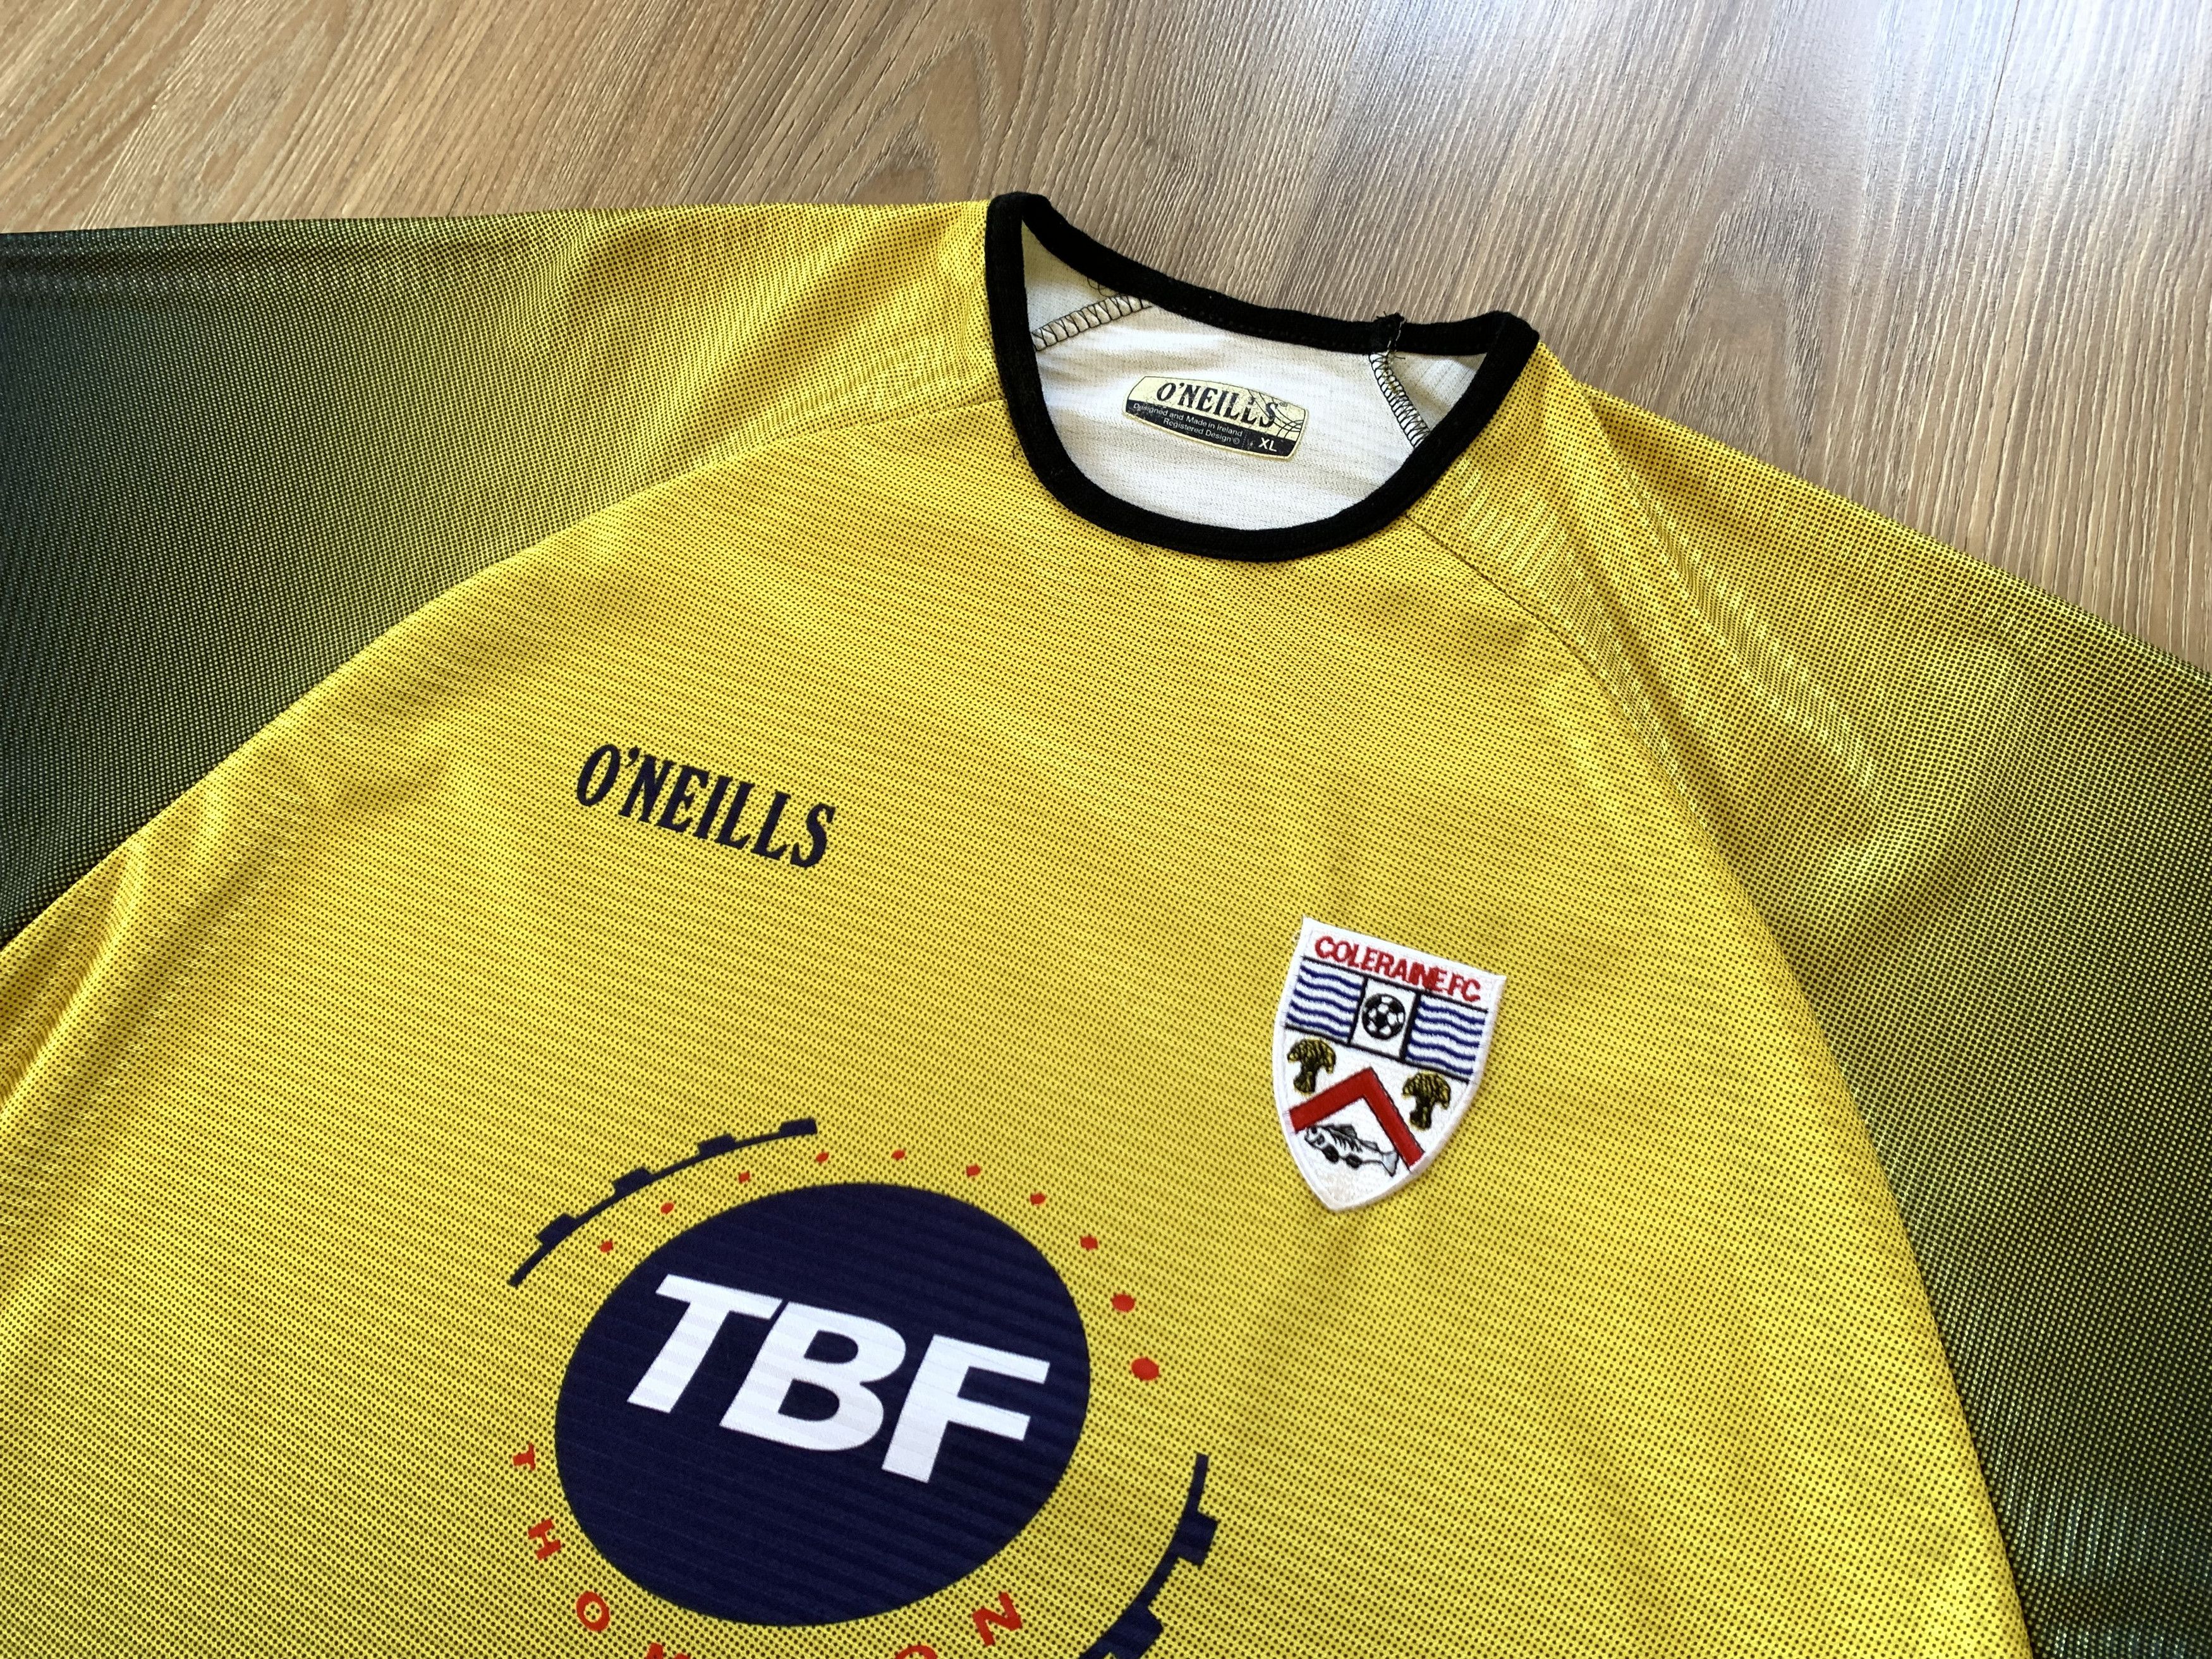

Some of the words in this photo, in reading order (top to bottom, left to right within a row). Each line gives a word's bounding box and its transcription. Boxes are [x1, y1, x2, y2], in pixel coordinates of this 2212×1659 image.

[1156, 382, 1278, 428] O'NEILLS
[1169, 412, 1184, 421] and
[1186, 415, 1208, 427] Made
[1217, 425, 1243, 437] Ireland
[1163, 416, 1204, 435] Registered
[1205, 429, 1232, 443] Design
[1258, 437, 1277, 452] XL
[576, 743, 836, 869] O'NEILLS
[1315, 935, 1447, 992] COLERAINE
[1446, 972, 1481, 1002] FC
[627, 1273, 1050, 1483] TBF
